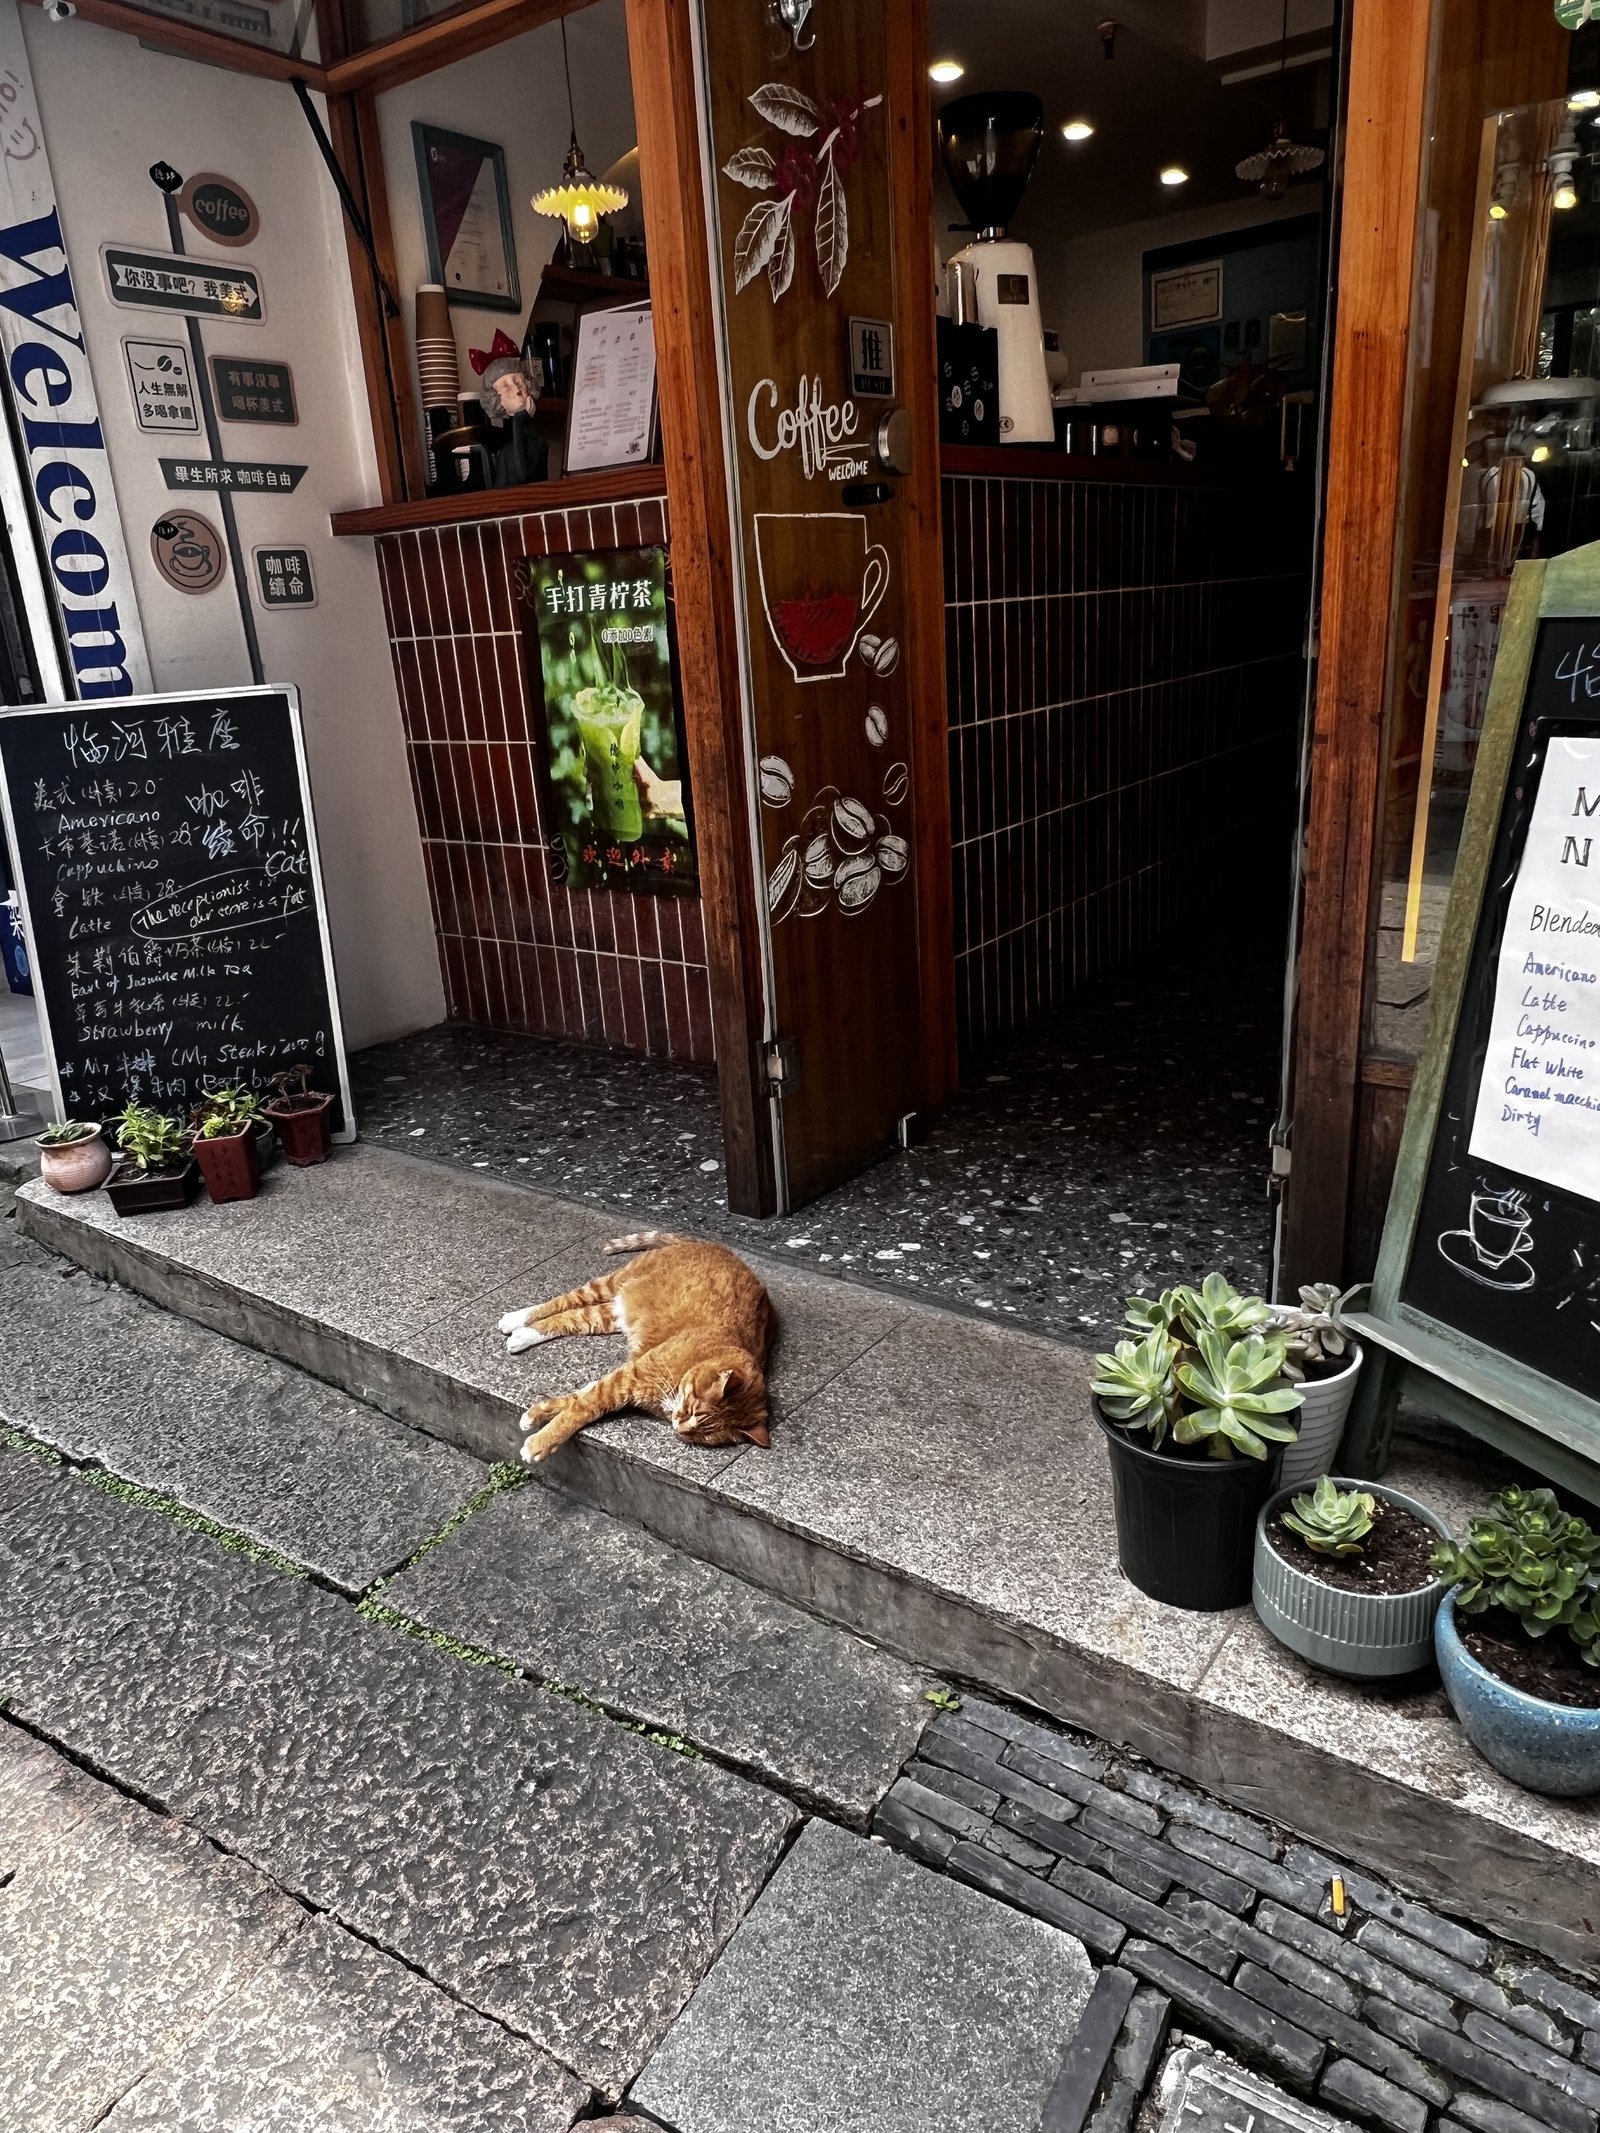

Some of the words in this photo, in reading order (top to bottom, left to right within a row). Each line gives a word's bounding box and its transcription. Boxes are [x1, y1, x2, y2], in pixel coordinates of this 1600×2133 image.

[195, 198, 248, 222] coffee
[861, 329, 883, 370] 推
[138, 381, 189, 398] 人生無解
[747, 374, 861, 481] Coffee
[237, 469, 291, 487] 咖啡自由
[828, 460, 869, 482] WELCOME
[265, 556, 301, 575] 咖啡
[269, 577, 304, 597] 續命
[545, 579, 653, 614] 手打青柠茶
[63, 707, 240, 768] 临河雅座
[58, 810, 160, 834] Americano
[189, 909, 212, 929] our
[252, 896, 265, 909] is
[267, 896, 279, 907] a
[280, 884, 307, 916] fat
[69, 917, 112, 940] Latte
[136, 909, 170, 930] The
[1522, 952, 1597, 985] Americano
[71, 980, 100, 999] Earl
[106, 974, 120, 996] of
[1521, 985, 1567, 1012] Latte
[1516, 1014, 1596, 1050] Cappuccino
[1510, 1046, 1540, 1069] Flat
[1501, 1104, 1542, 1137] Dirty
